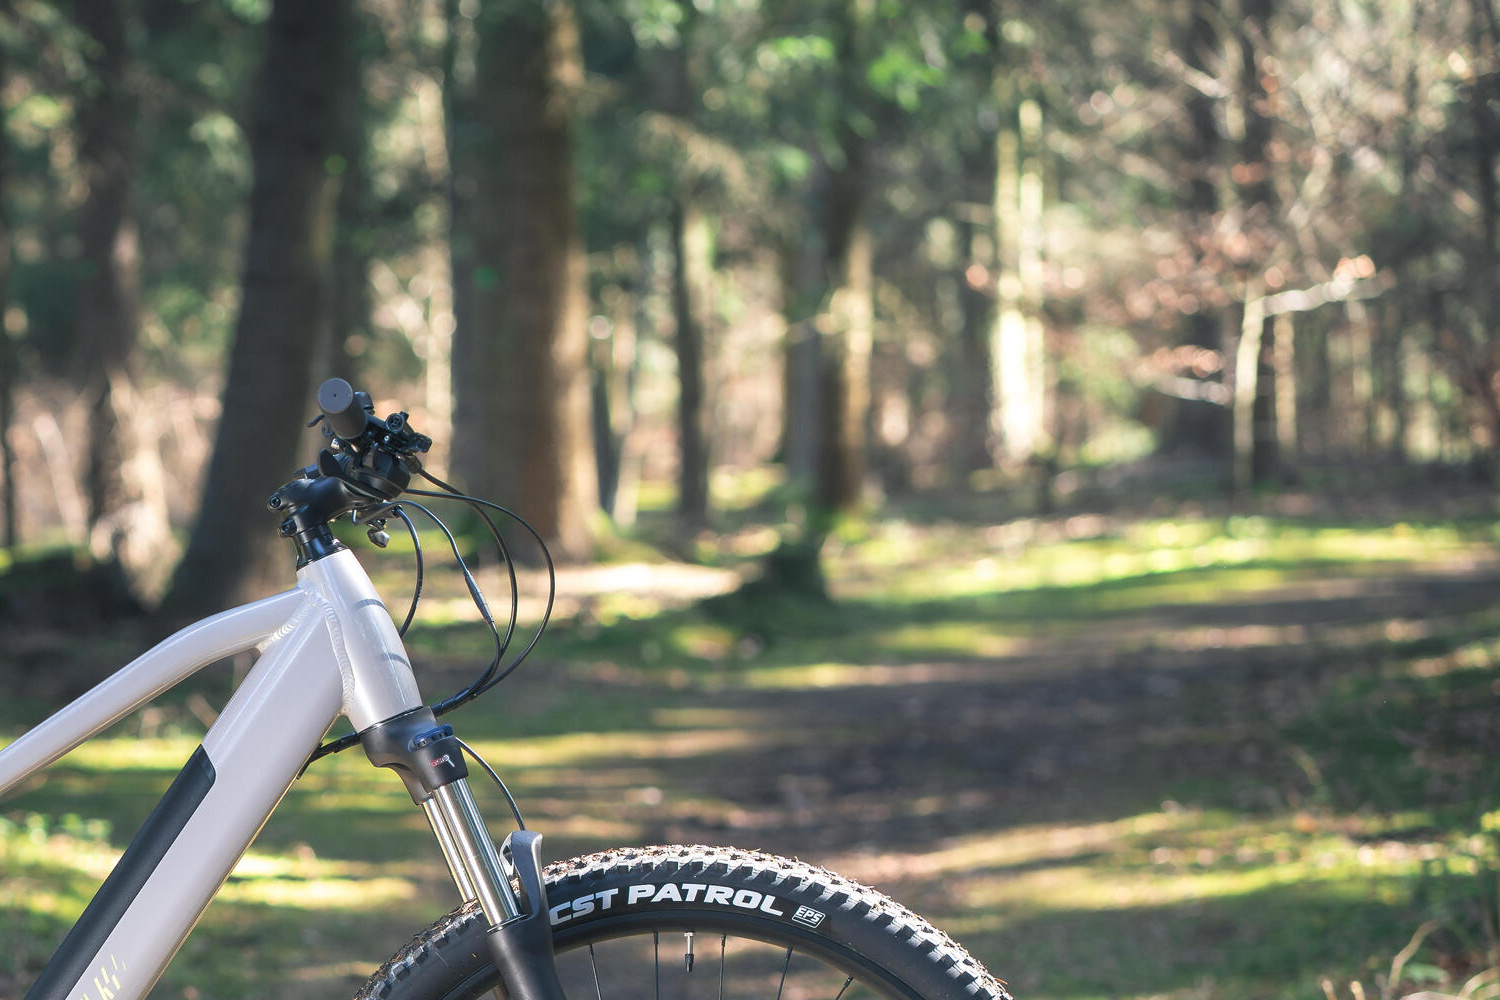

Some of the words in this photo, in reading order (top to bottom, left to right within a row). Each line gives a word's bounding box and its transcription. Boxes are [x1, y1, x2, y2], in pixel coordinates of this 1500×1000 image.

[549, 888, 619, 926] CST
[627, 883, 784, 916] PATROL
[795, 907, 823, 922] EPS
